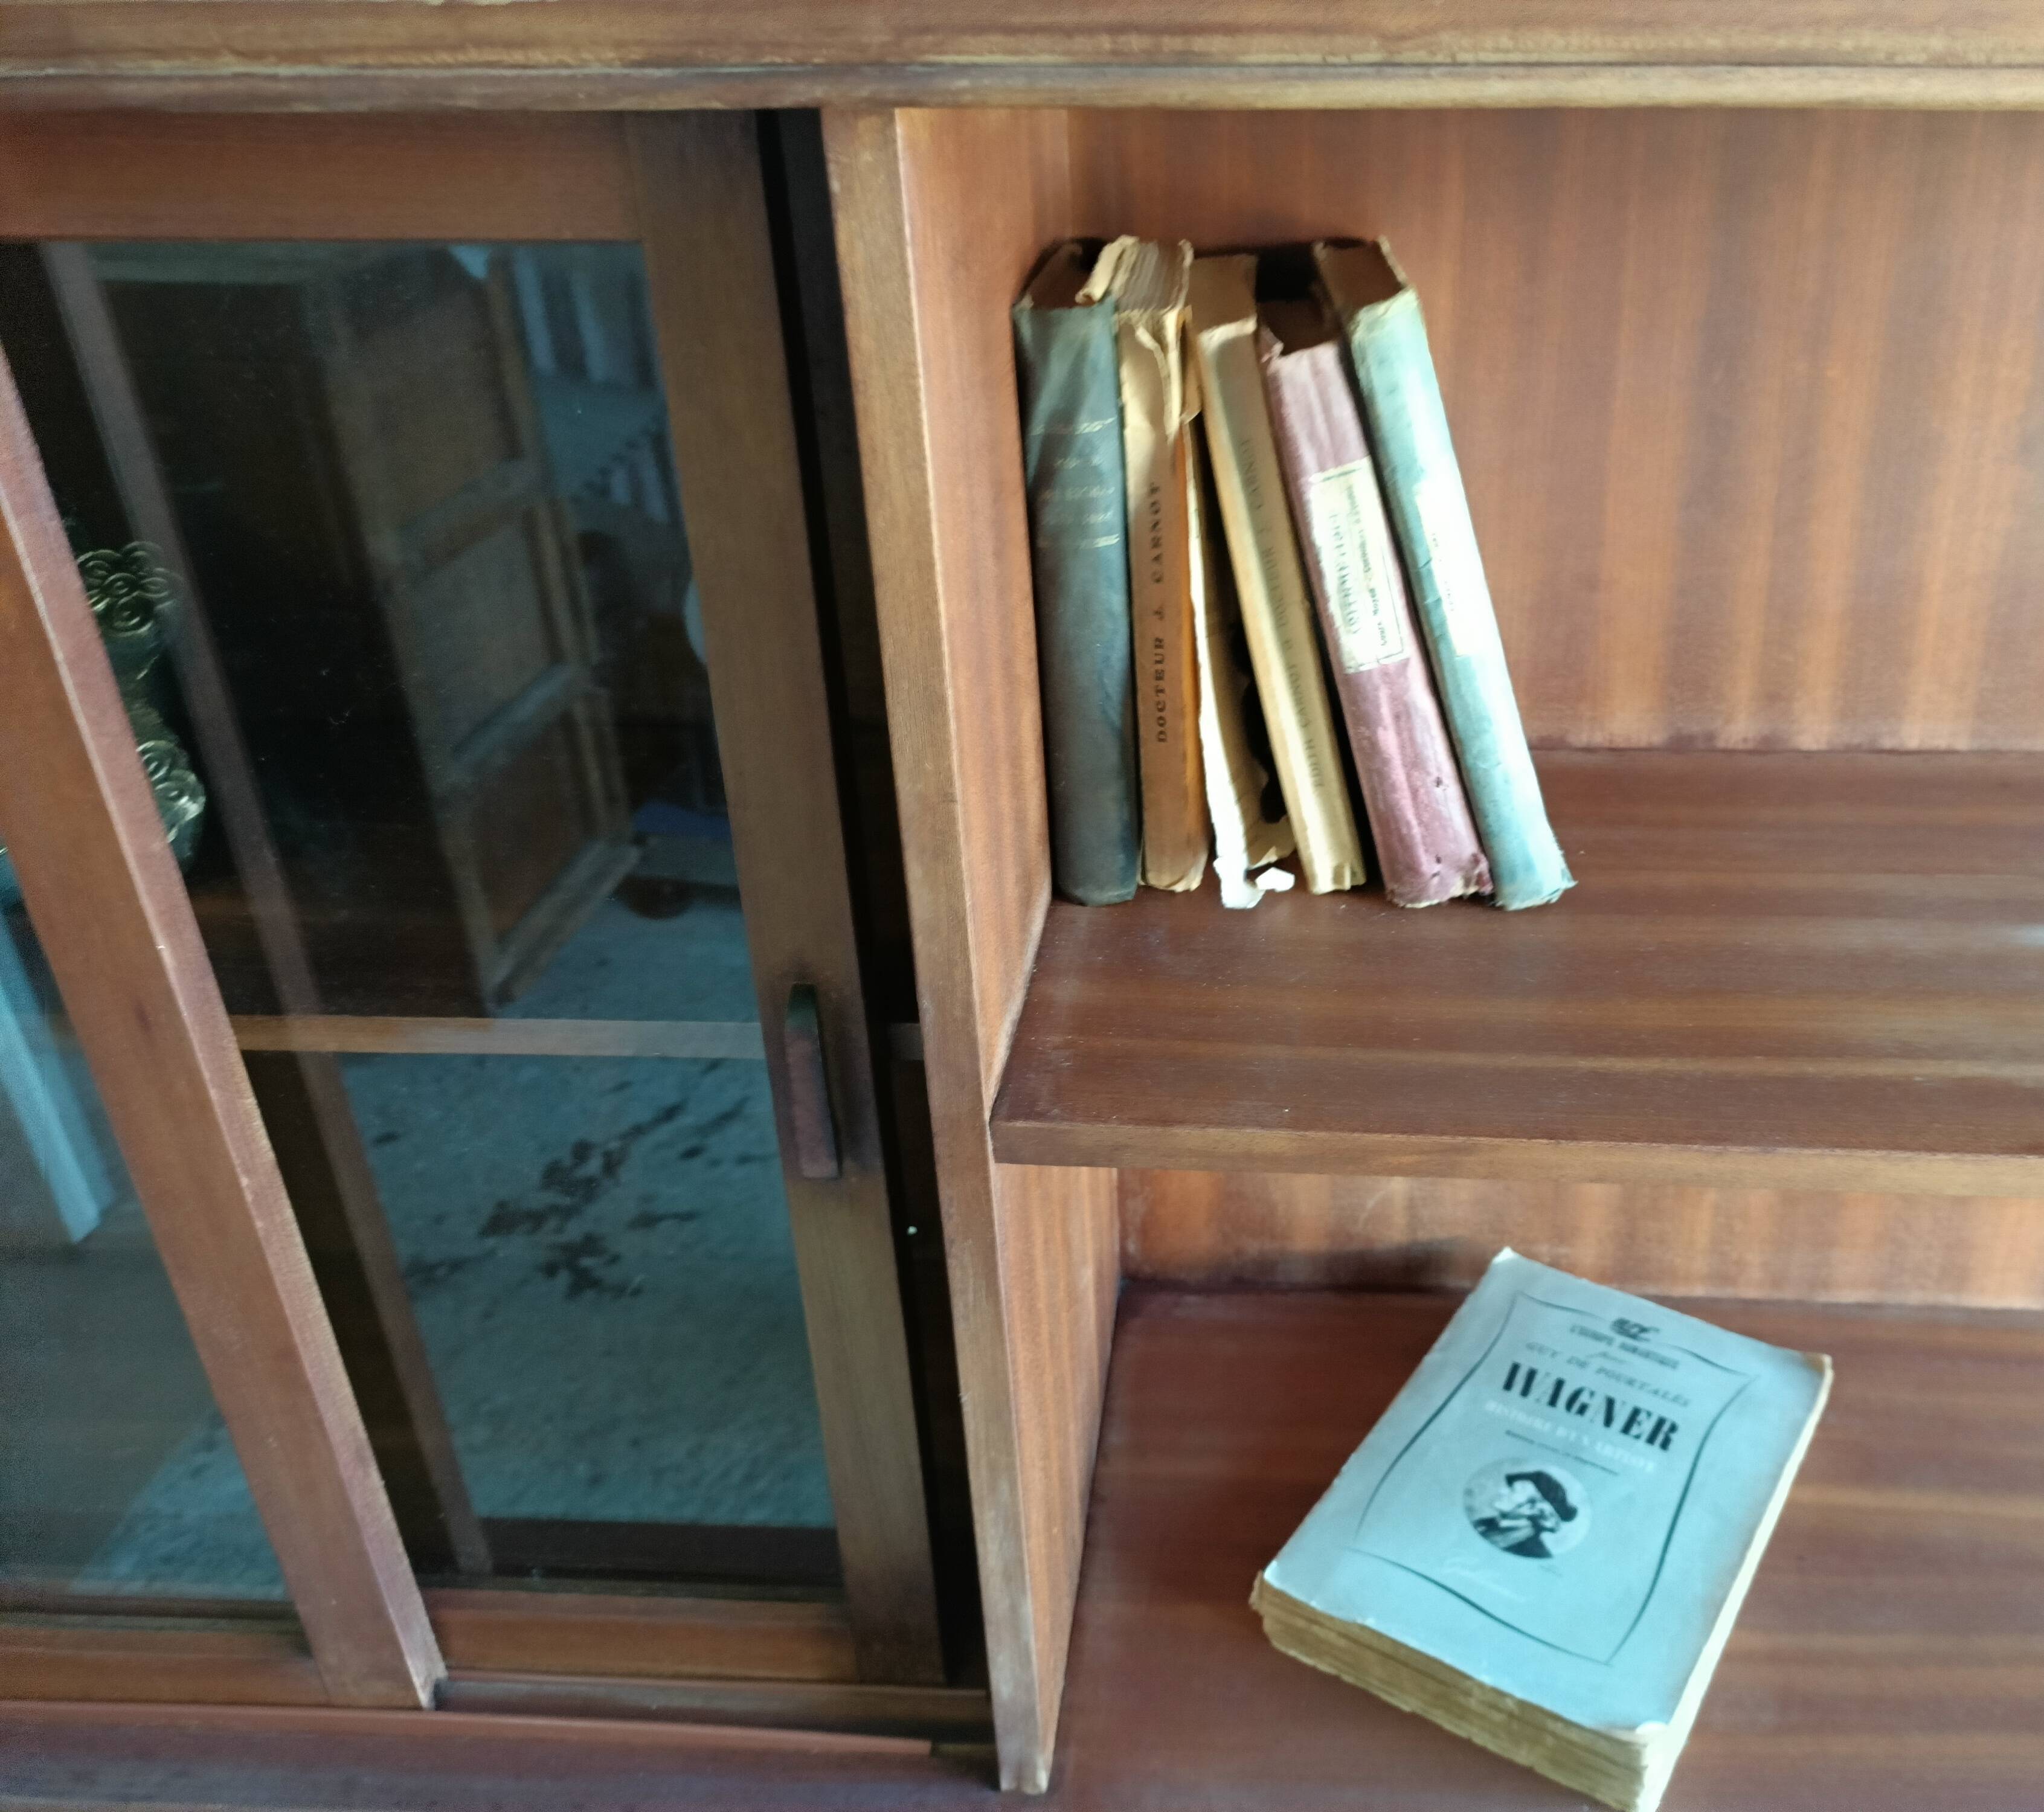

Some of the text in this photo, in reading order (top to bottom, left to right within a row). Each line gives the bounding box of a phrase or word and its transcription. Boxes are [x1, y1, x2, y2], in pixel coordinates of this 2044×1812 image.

[1149, 482, 1164, 585] CARNOT
[1154, 637, 1168, 743] DOCTEUR
[1502, 1361, 1679, 1451] WAGNER
